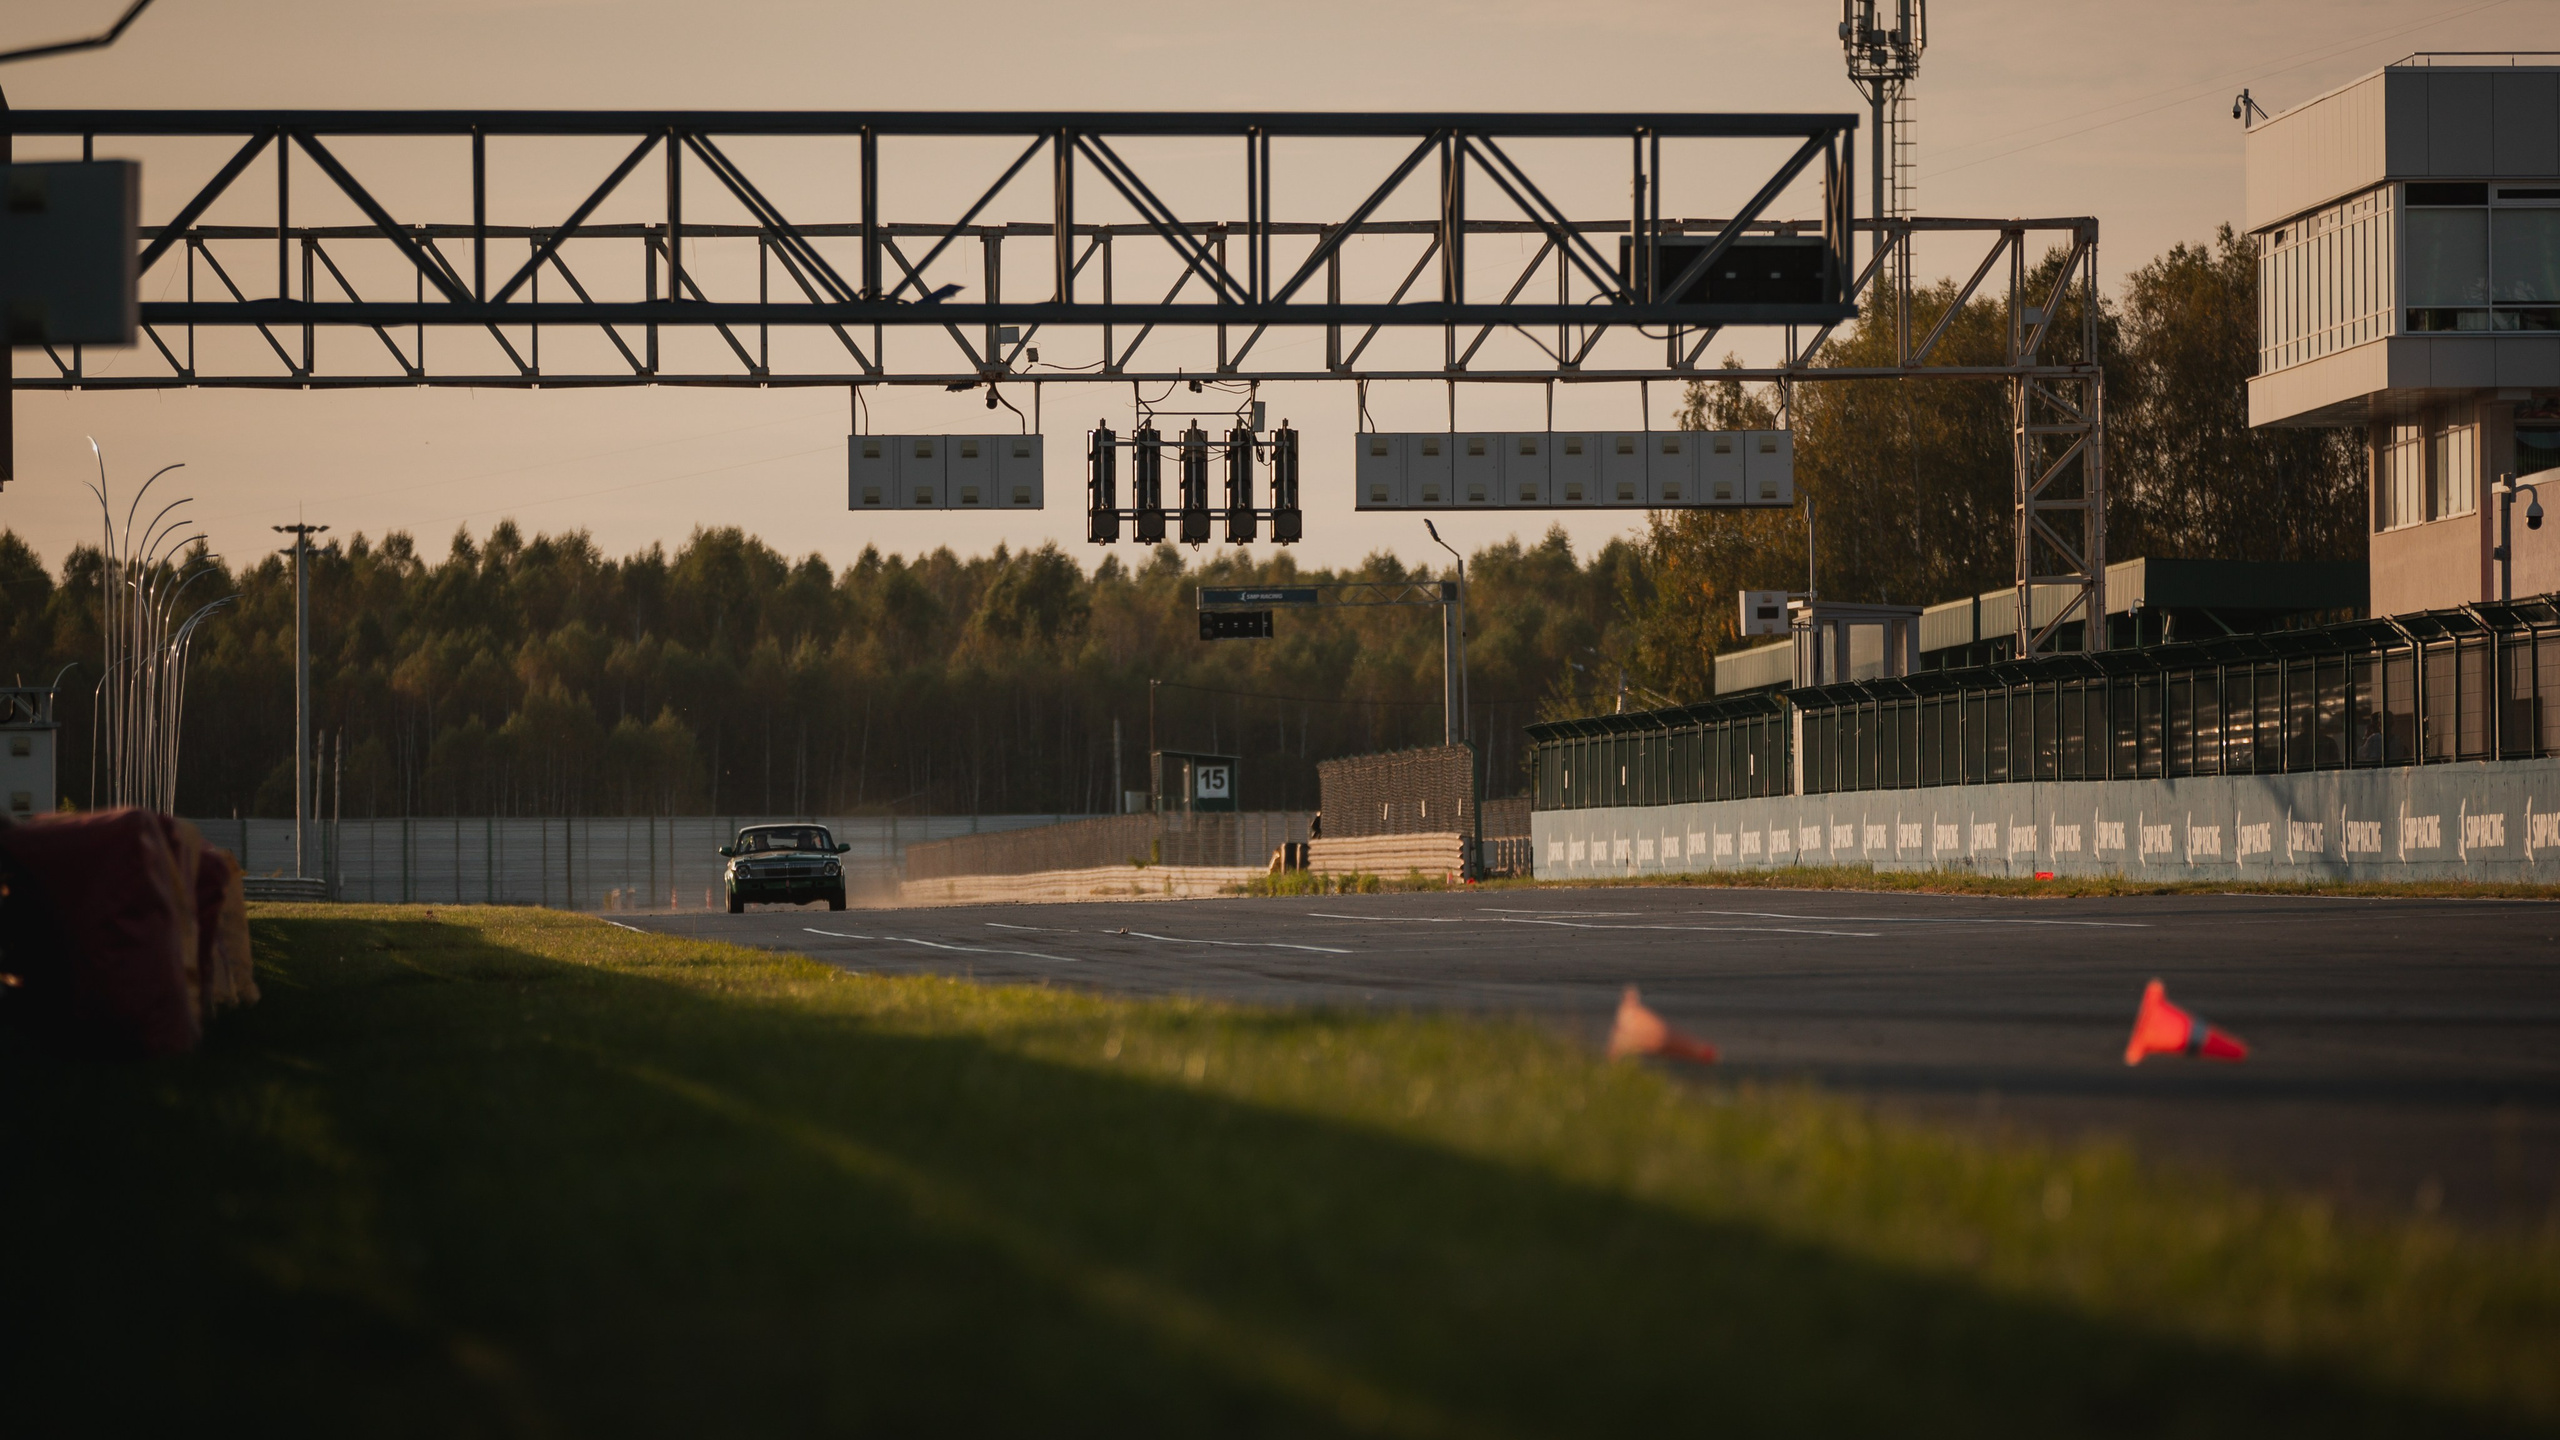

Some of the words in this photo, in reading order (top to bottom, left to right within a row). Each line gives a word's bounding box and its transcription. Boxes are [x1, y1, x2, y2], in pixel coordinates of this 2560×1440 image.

[1201, 769, 1225, 790] 15
[2405, 818, 2417, 849] SMP
[2418, 815, 2440, 848] RACING
[2466, 816, 2480, 849] SMP
[2480, 813, 2504, 847] RACING
[2533, 814, 2547, 849] SMP
